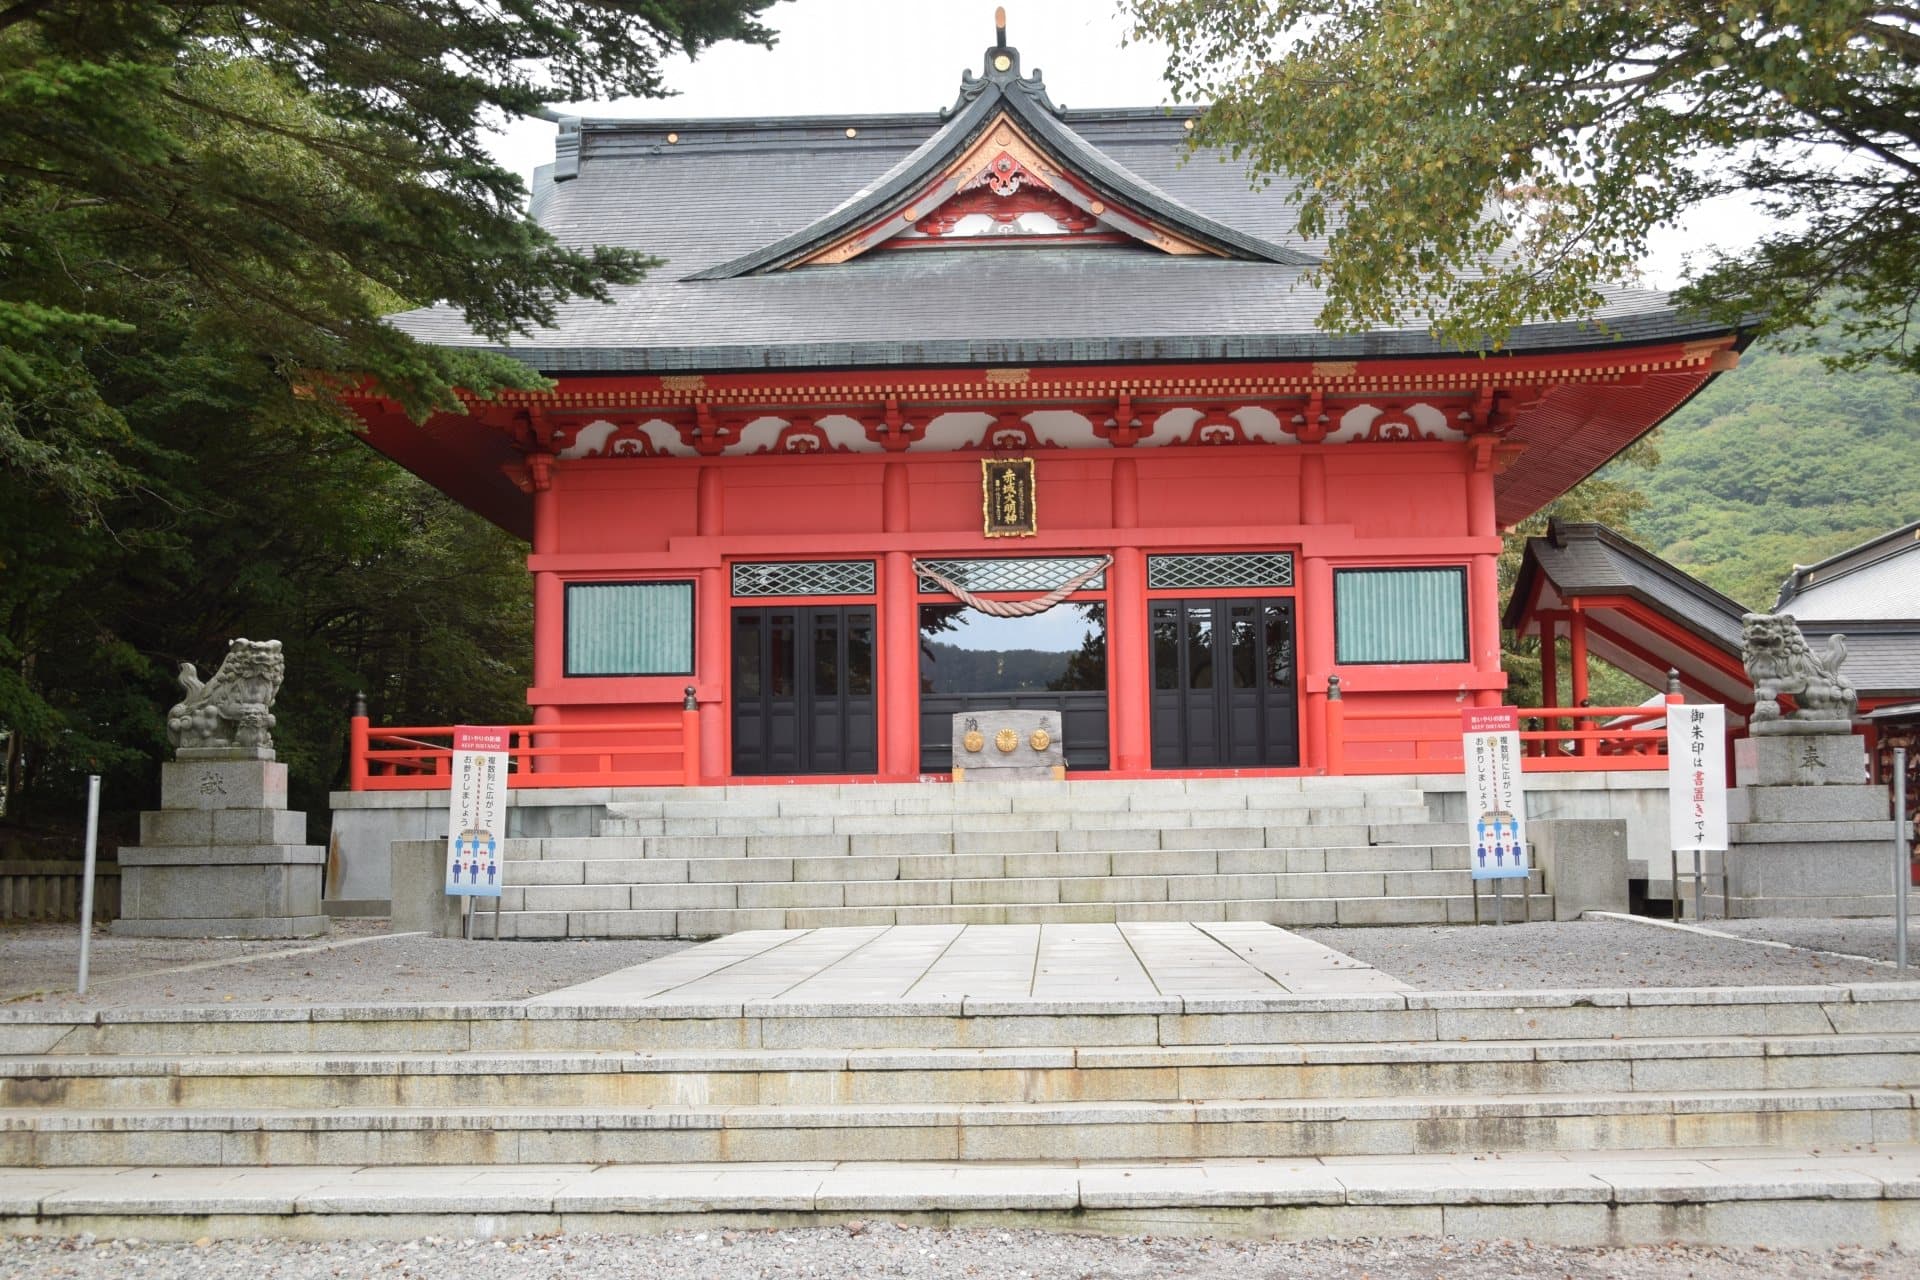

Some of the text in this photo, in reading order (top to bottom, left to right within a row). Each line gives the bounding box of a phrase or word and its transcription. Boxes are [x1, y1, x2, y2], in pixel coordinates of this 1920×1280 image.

[1002, 468, 1018, 525] 赤城大明神
[199, 771, 227, 795] 献
[460, 755, 472, 827] お参りしましょう
[485, 756, 497, 828] 複数列に広がって
[1475, 737, 1488, 809] お参りしましょう
[1500, 736, 1512, 808] 複数列に広がって
[1690, 708, 1705, 845] 御朱印は書置きです
[1798, 745, 1827, 772] 奉
